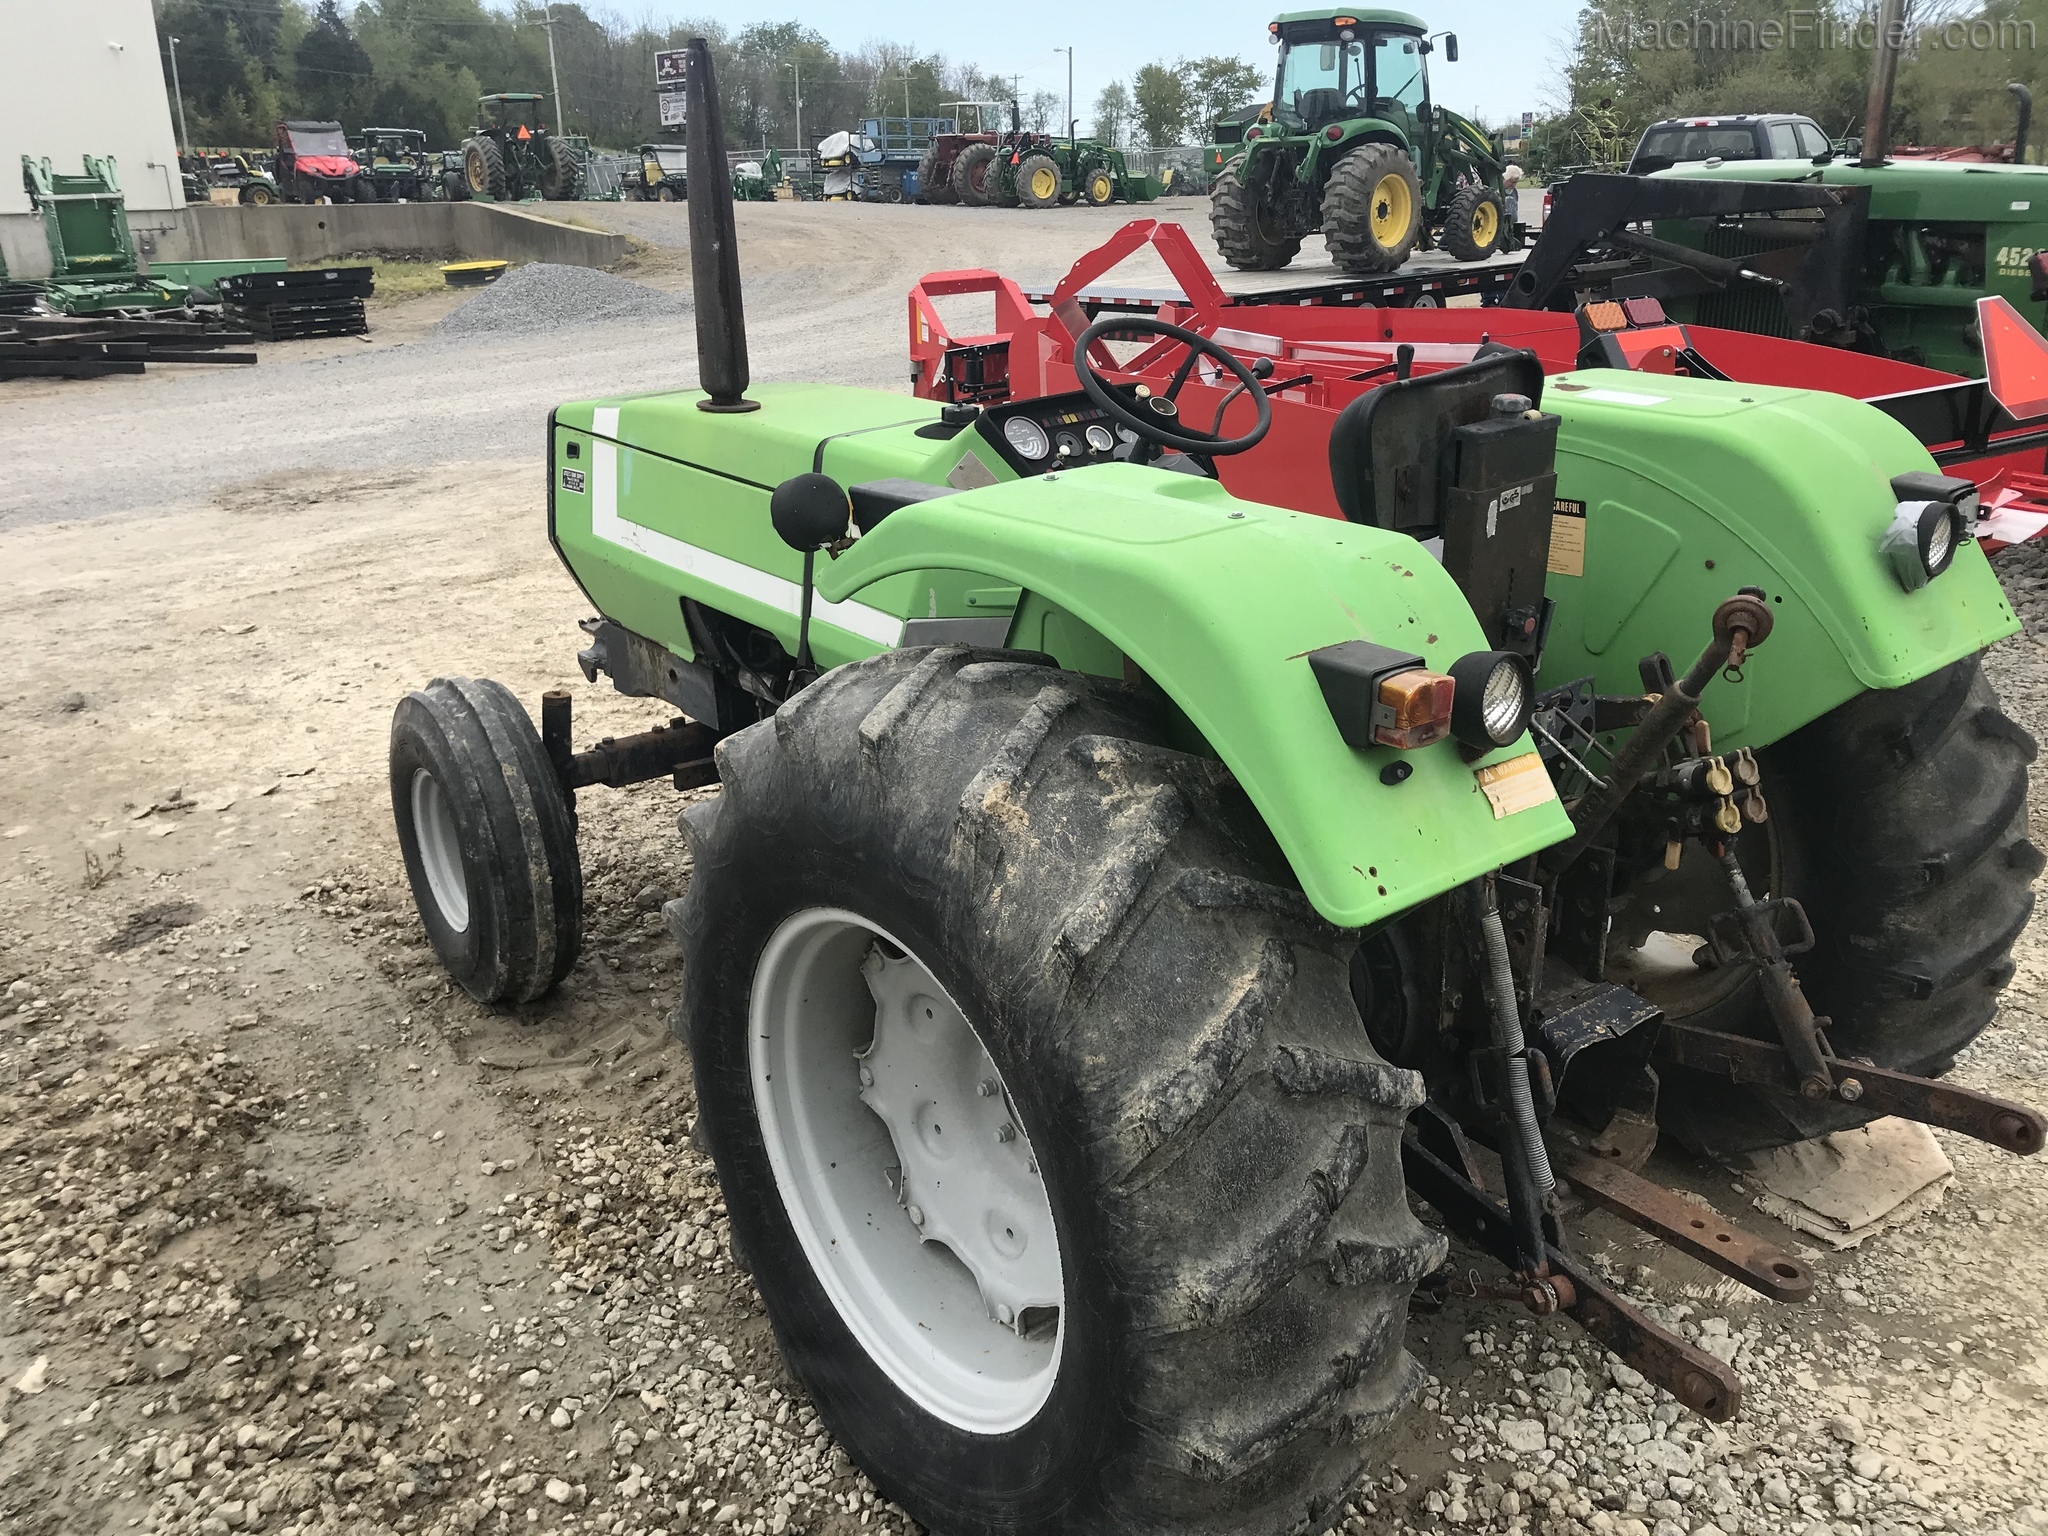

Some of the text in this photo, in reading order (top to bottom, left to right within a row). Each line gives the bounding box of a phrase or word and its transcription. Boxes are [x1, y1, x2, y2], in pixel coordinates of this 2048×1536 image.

[1997, 247, 2046, 267] 452
[2000, 268, 2032, 277] DIESE
[1495, 754, 1536, 776] WARNING
